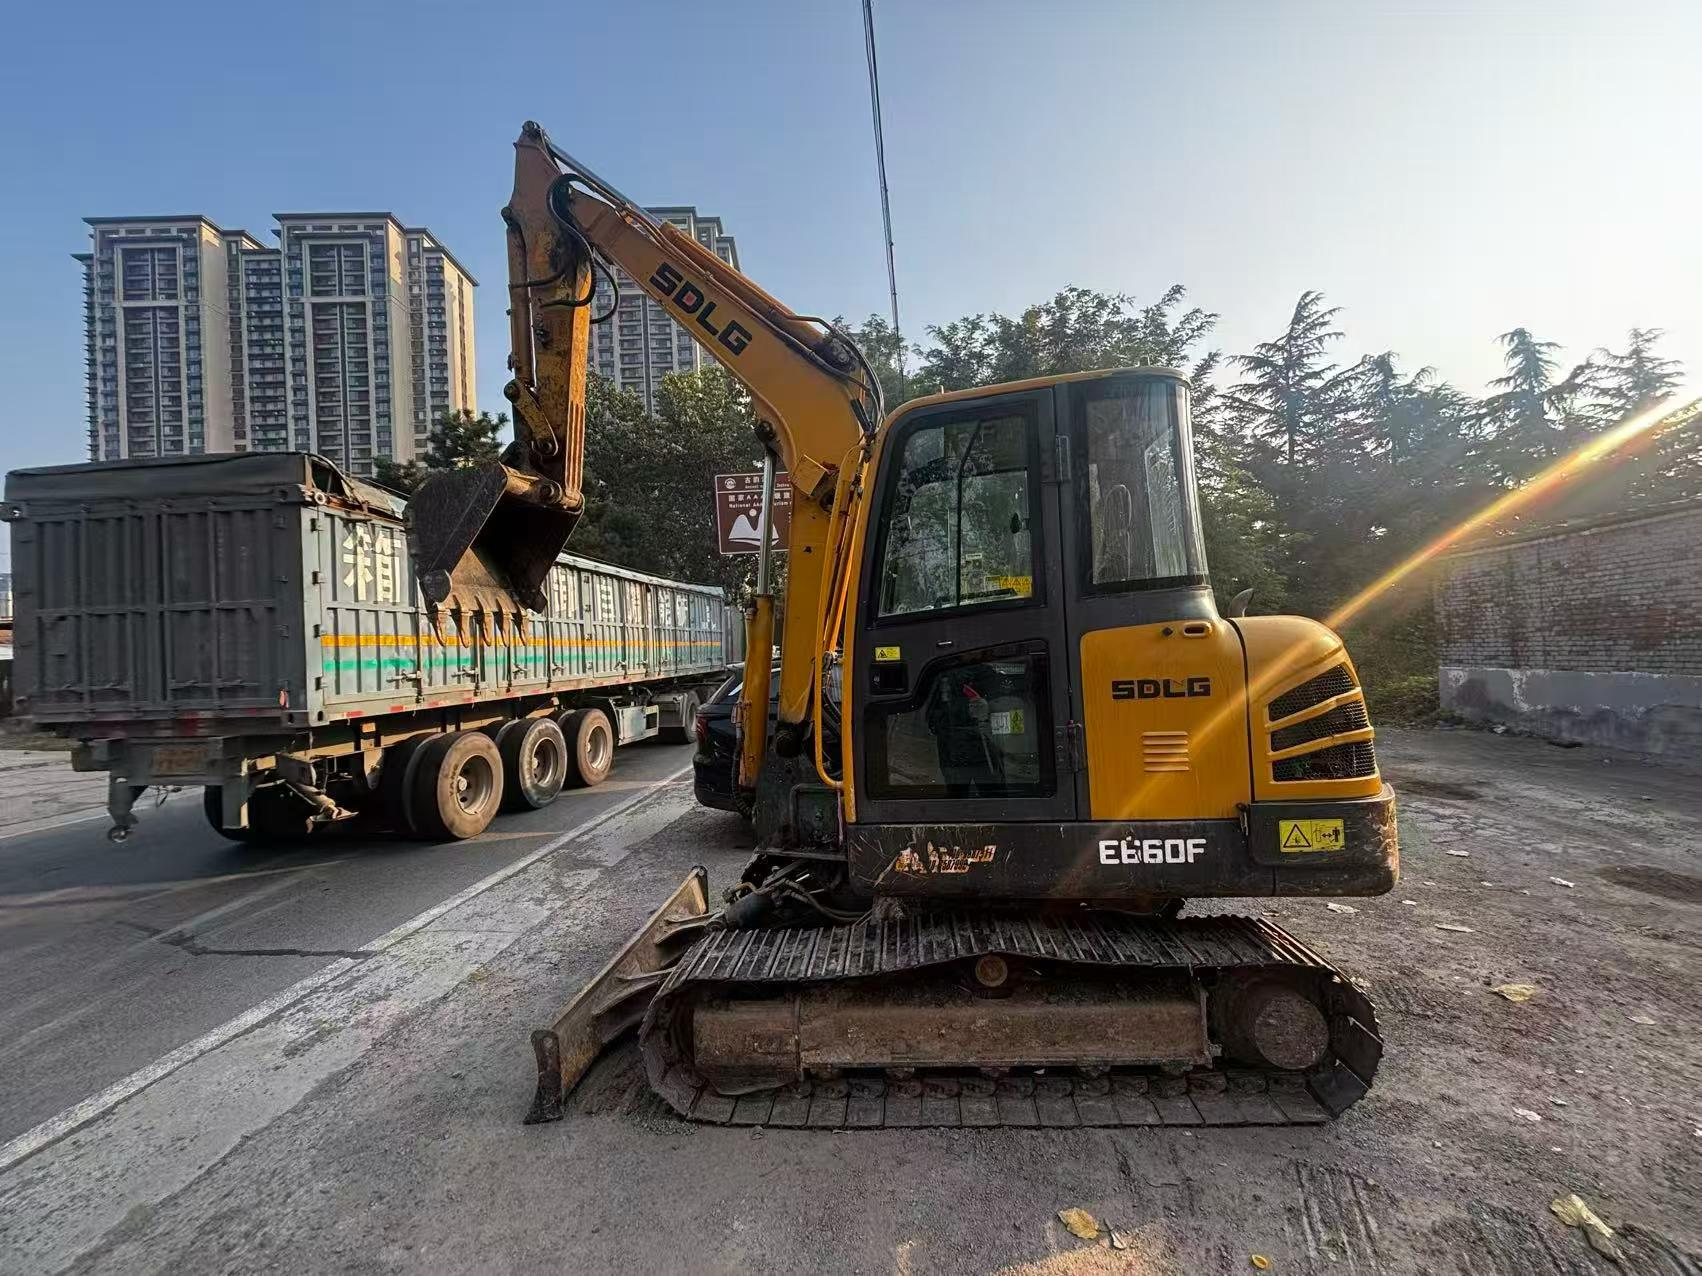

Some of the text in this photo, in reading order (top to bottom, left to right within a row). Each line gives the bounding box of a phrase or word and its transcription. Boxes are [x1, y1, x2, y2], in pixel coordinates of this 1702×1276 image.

[649, 262, 753, 356] SDLG
[343, 524, 402, 603] 箱
[1111, 677, 1211, 700] SDLG
[1098, 838, 1207, 864] E660F
